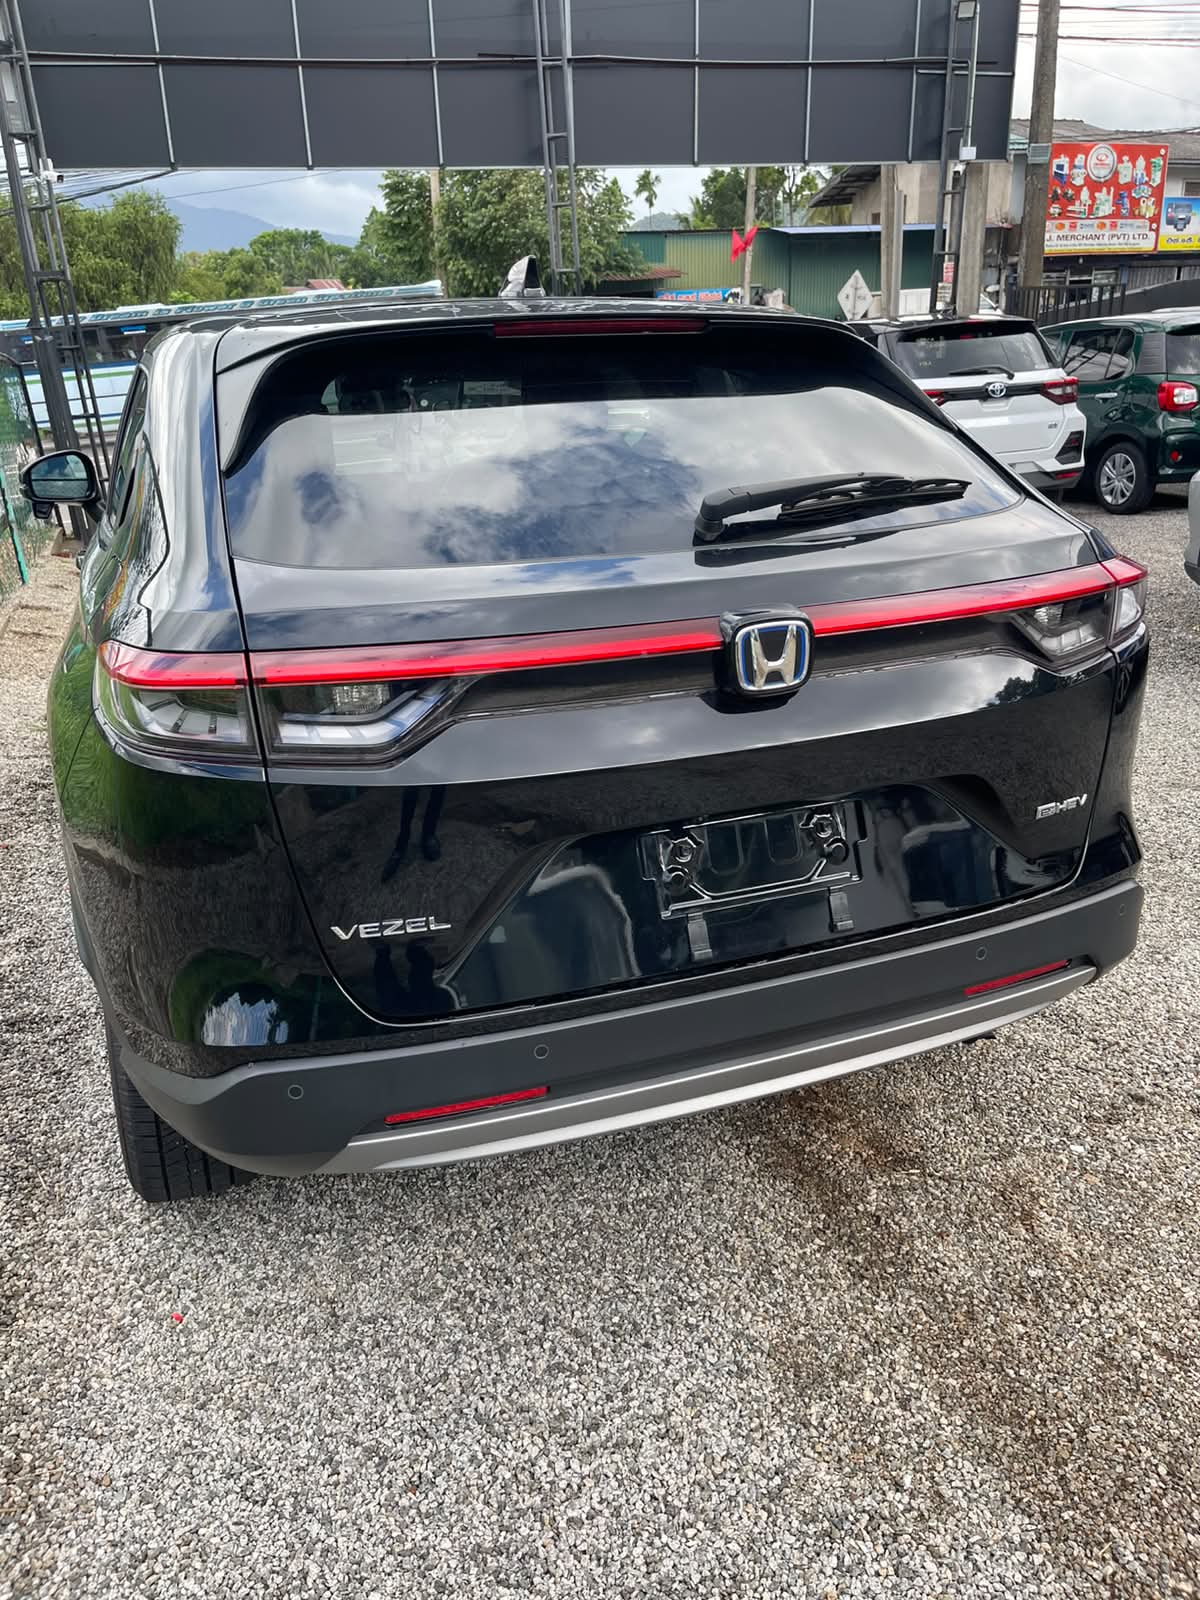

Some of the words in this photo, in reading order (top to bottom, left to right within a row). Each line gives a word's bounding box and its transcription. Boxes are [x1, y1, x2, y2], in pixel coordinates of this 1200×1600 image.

[1056, 233, 1106, 241] MERCHANT
[1108, 232, 1130, 241] (PVT)
[330, 916, 452, 940] VEZEL
